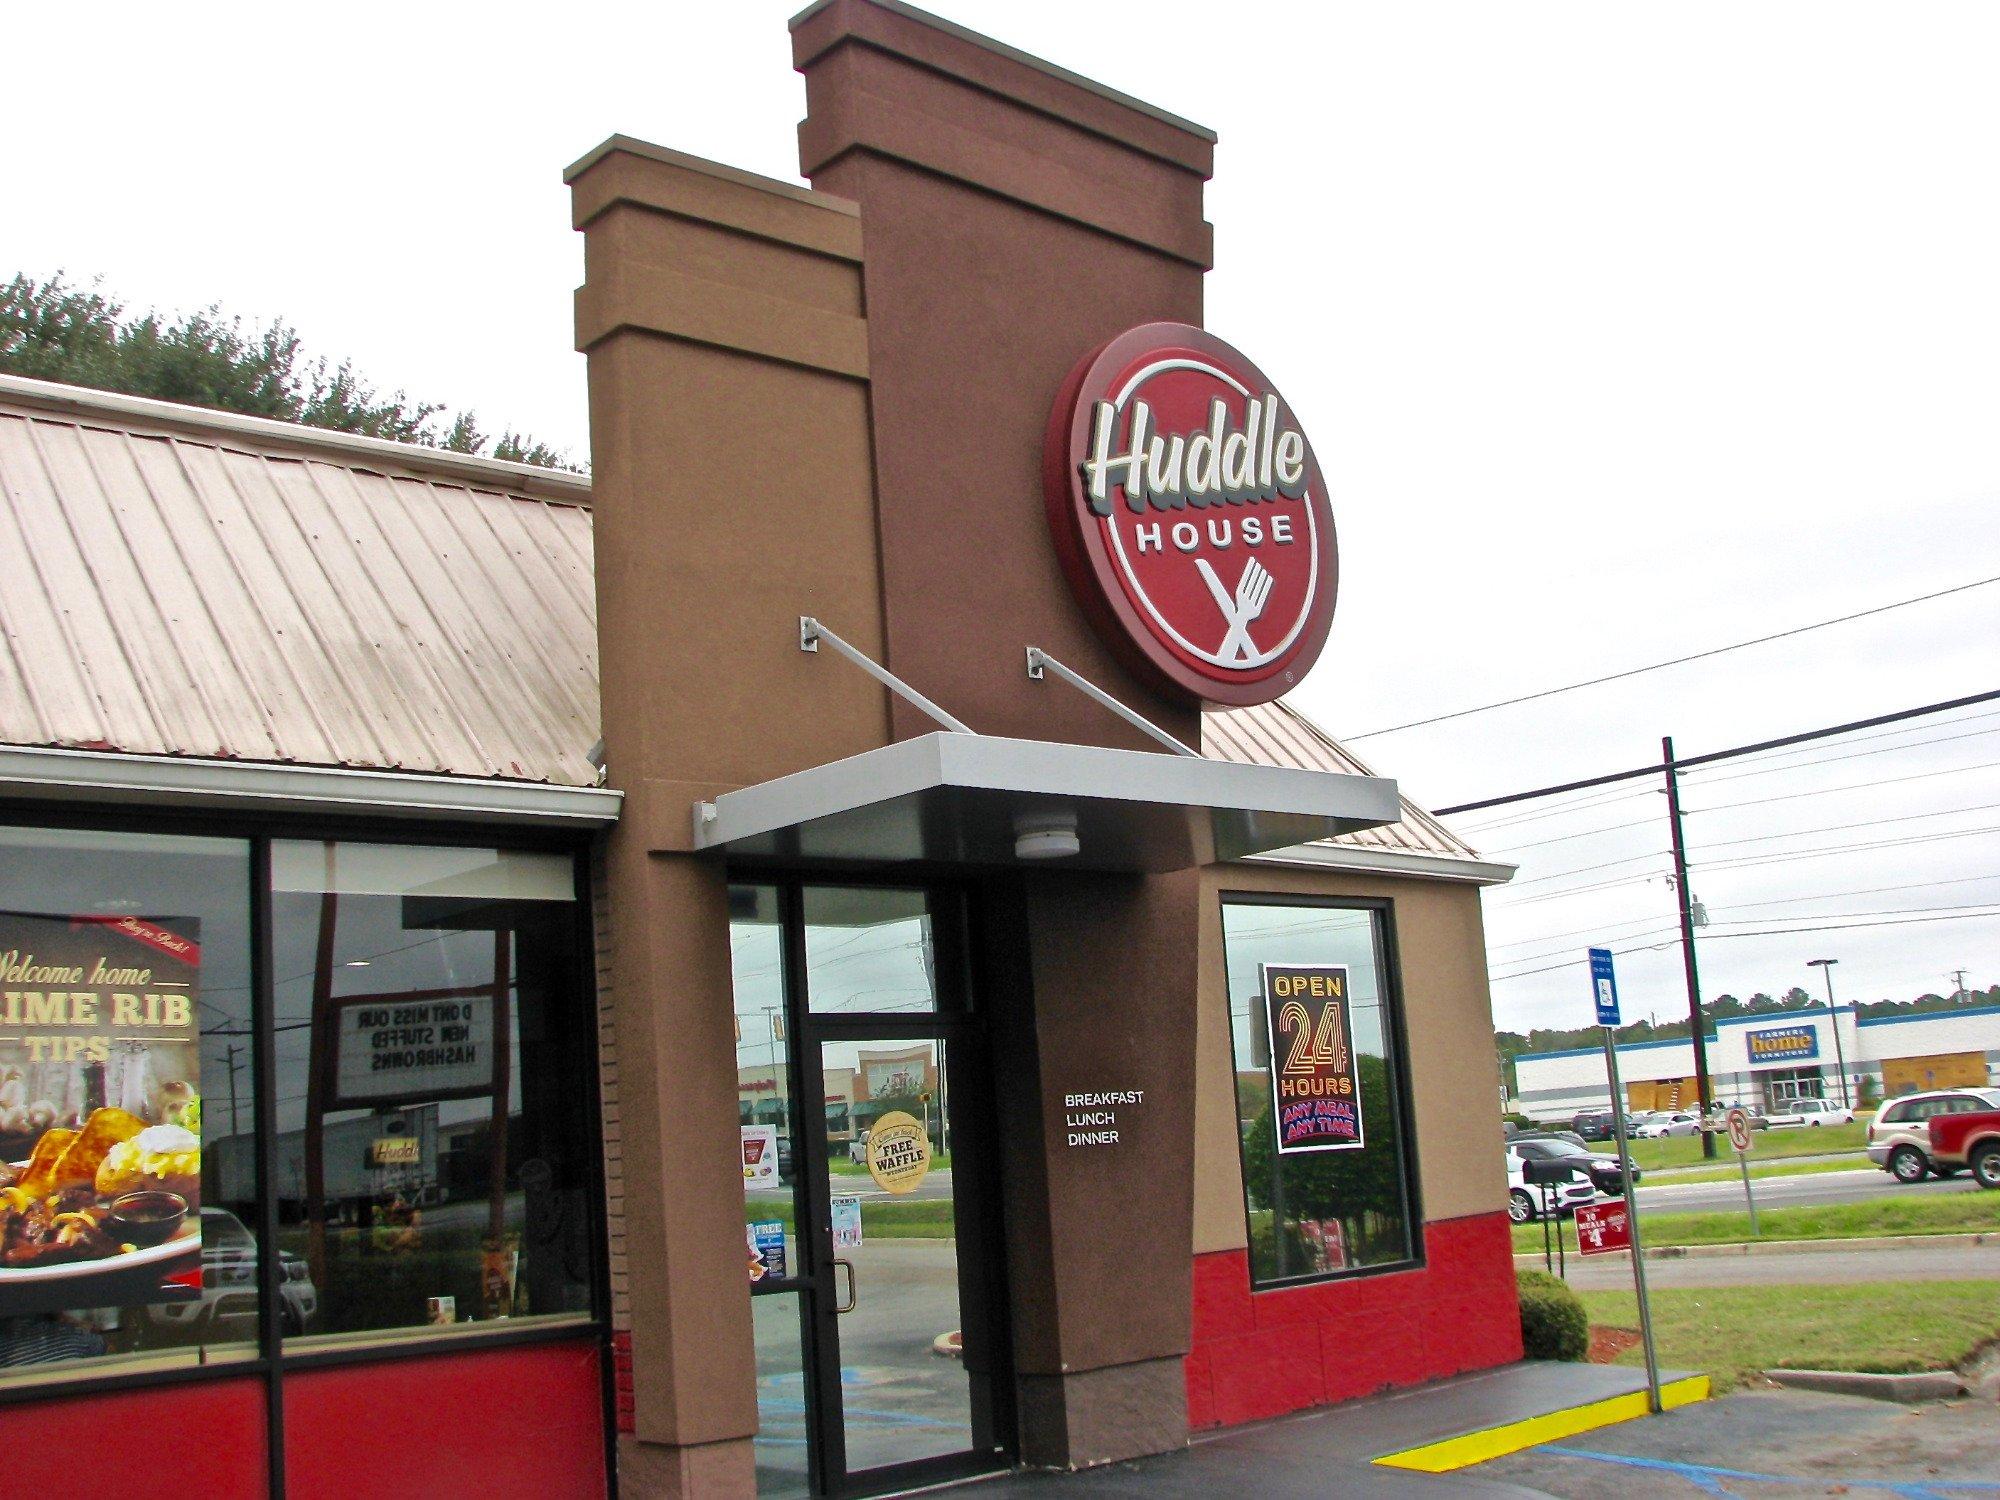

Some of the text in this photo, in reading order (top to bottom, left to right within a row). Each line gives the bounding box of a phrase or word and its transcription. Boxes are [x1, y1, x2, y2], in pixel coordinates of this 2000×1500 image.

[1085, 394, 1304, 499] Huddle
[1135, 515, 1294, 554] HOUSE
[88, 956, 151, 986] home
[1274, 976, 1342, 997] OPEN
[0, 991, 192, 1028] IME RIB
[1279, 1001, 1348, 1074] 24
[1750, 1034, 1813, 1054] home
[24, 1036, 111, 1064] TIPS
[1281, 1077, 1352, 1097] HOURS
[1065, 1090, 1144, 1107] BREAKFAST
[1066, 1112, 1115, 1127] LUNCH
[1284, 1101, 1355, 1125] ANY MEAL
[1068, 1130, 1119, 1147] DINNER
[1287, 1117, 1355, 1140] ANY TIME
[882, 1140, 913, 1157] FREE
[876, 1150, 925, 1171] WAFFLE
[1578, 1220, 1606, 1230] MEALS
